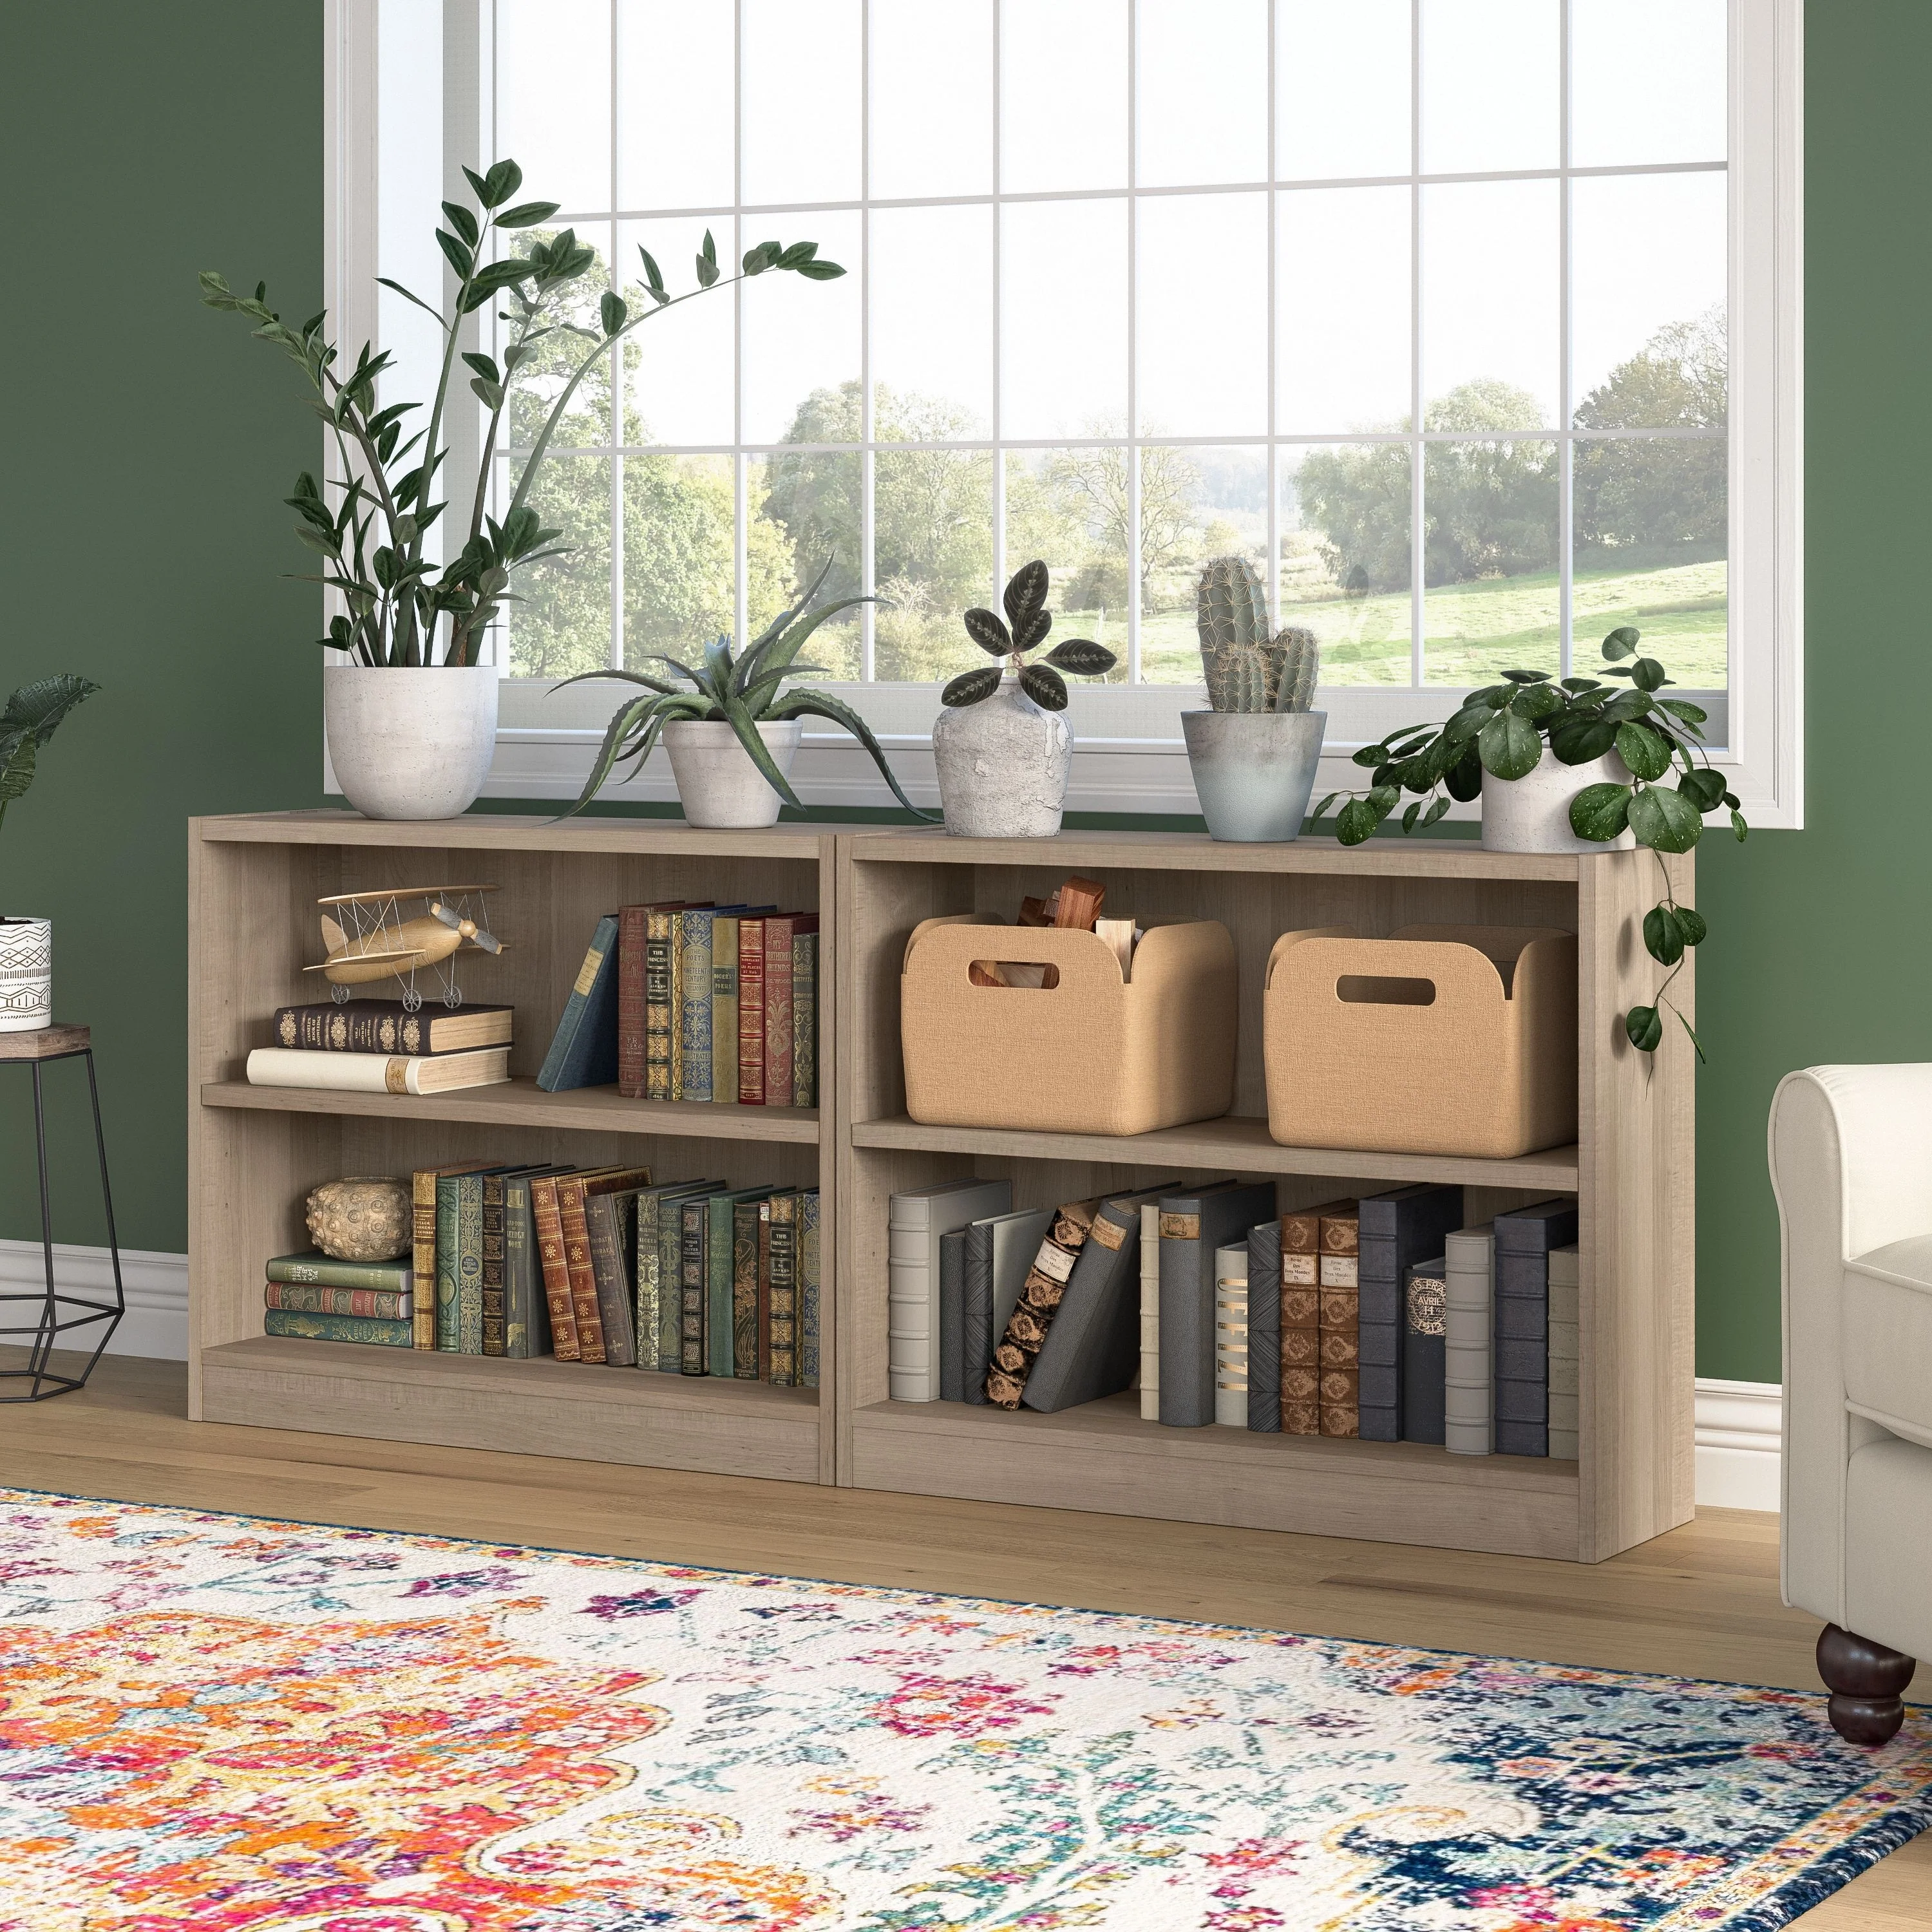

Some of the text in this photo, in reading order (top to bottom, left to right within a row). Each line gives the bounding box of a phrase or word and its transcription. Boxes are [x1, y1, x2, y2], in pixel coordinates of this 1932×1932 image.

[773, 940, 781, 949] MY
[507, 1240, 522, 1248] WORK
[1417, 1296, 1444, 1306] AVRIL
[1423, 1305, 1435, 1315] 14
